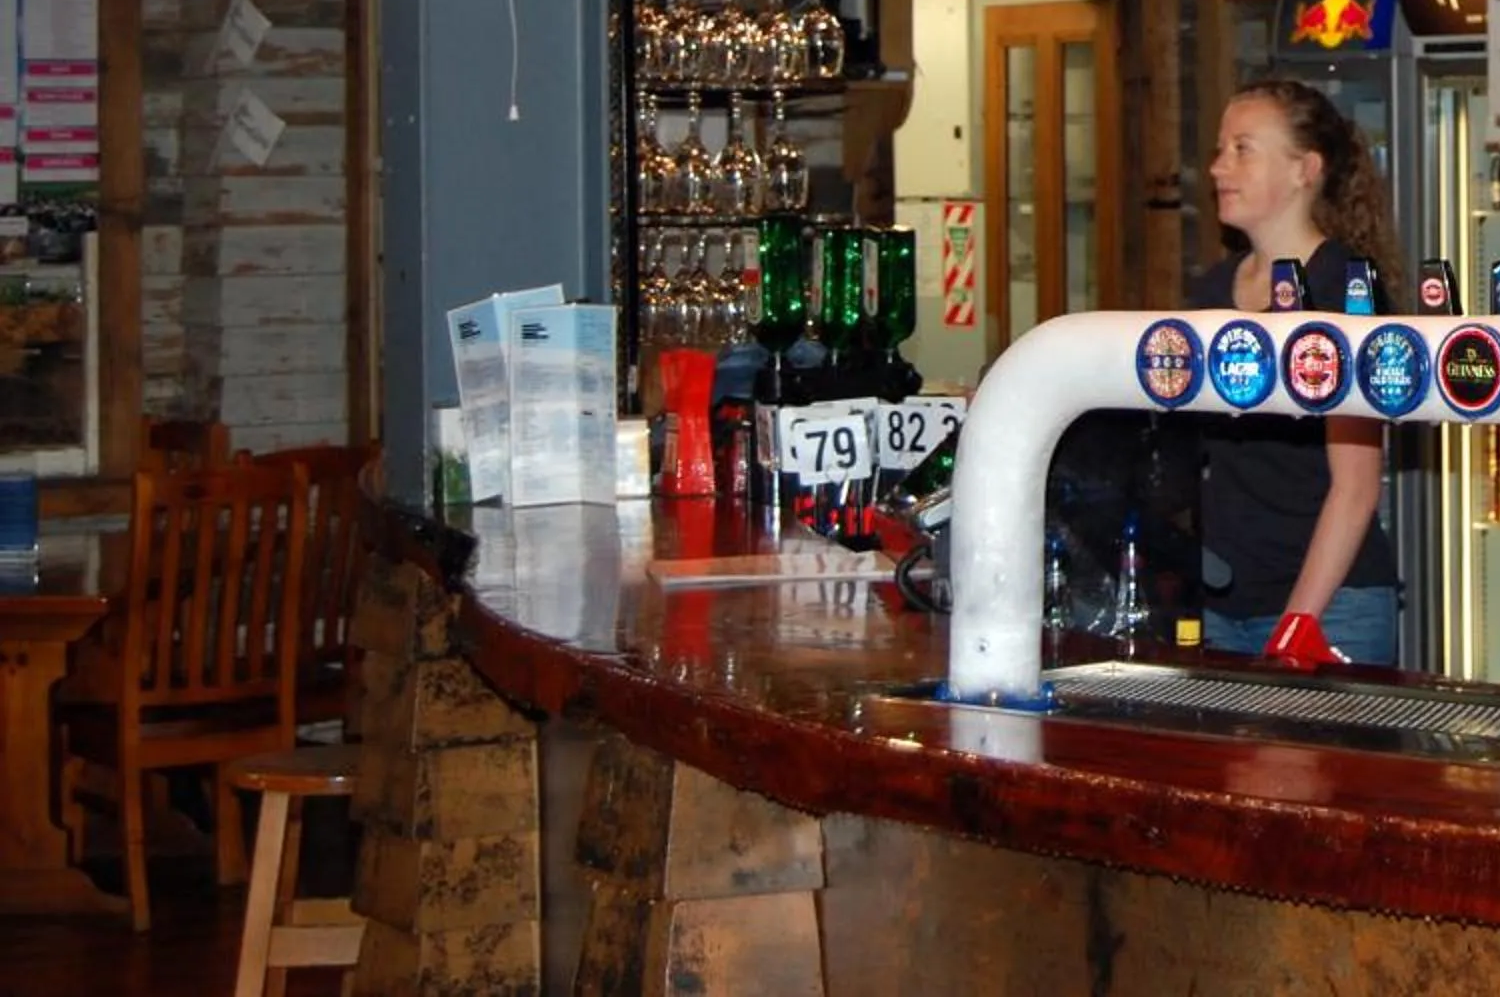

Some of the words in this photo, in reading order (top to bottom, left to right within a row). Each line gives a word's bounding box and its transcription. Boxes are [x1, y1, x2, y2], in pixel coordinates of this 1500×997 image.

[1446, 363, 1496, 380] GUINNESS
[805, 426, 858, 473] 79
[888, 410, 927, 453] 82
